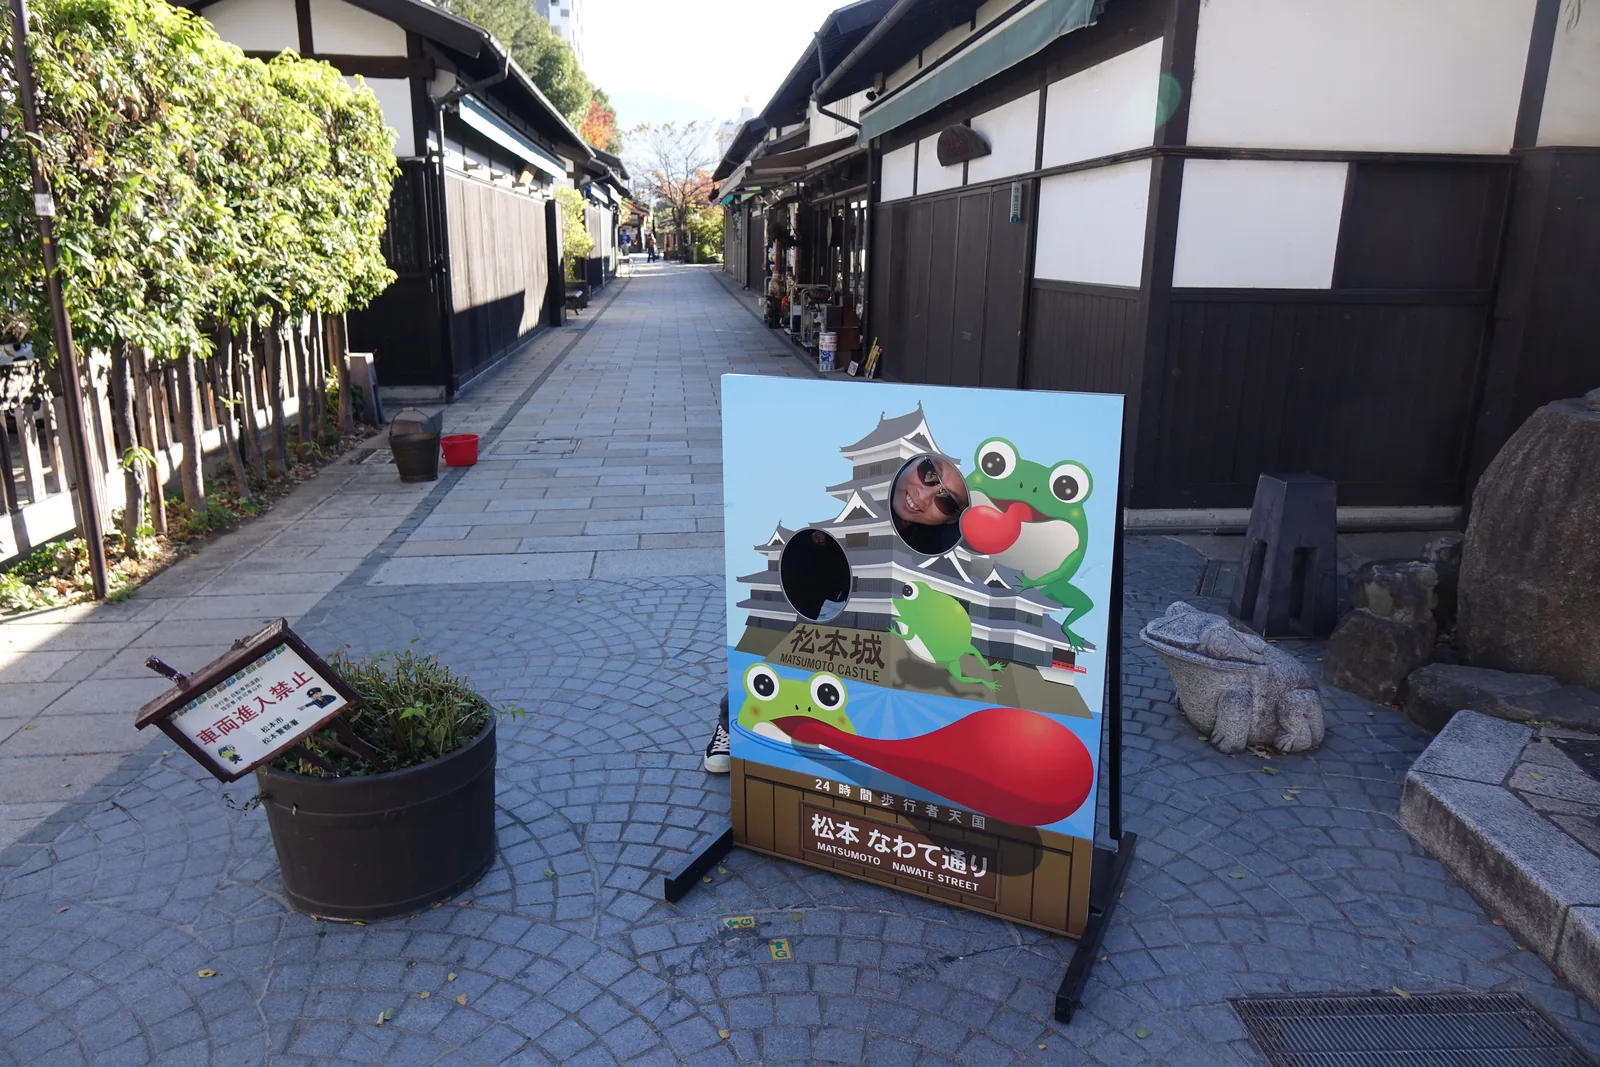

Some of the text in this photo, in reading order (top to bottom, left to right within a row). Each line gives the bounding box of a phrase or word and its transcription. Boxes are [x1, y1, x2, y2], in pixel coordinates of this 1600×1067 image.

[789, 624, 885, 670] 松本城
[779, 653, 880, 683] MATSUMOTO CASTLE
[196, 669, 314, 747] 車両進入禁止
[260, 716, 284, 734] 松本市
[261, 719, 300, 745] 松本警察署
[811, 814, 989, 878] 松本 なわて通り
[817, 842, 980, 891] MATSUMOTO NAWATE STREET
[775, 949, 788, 958] G
